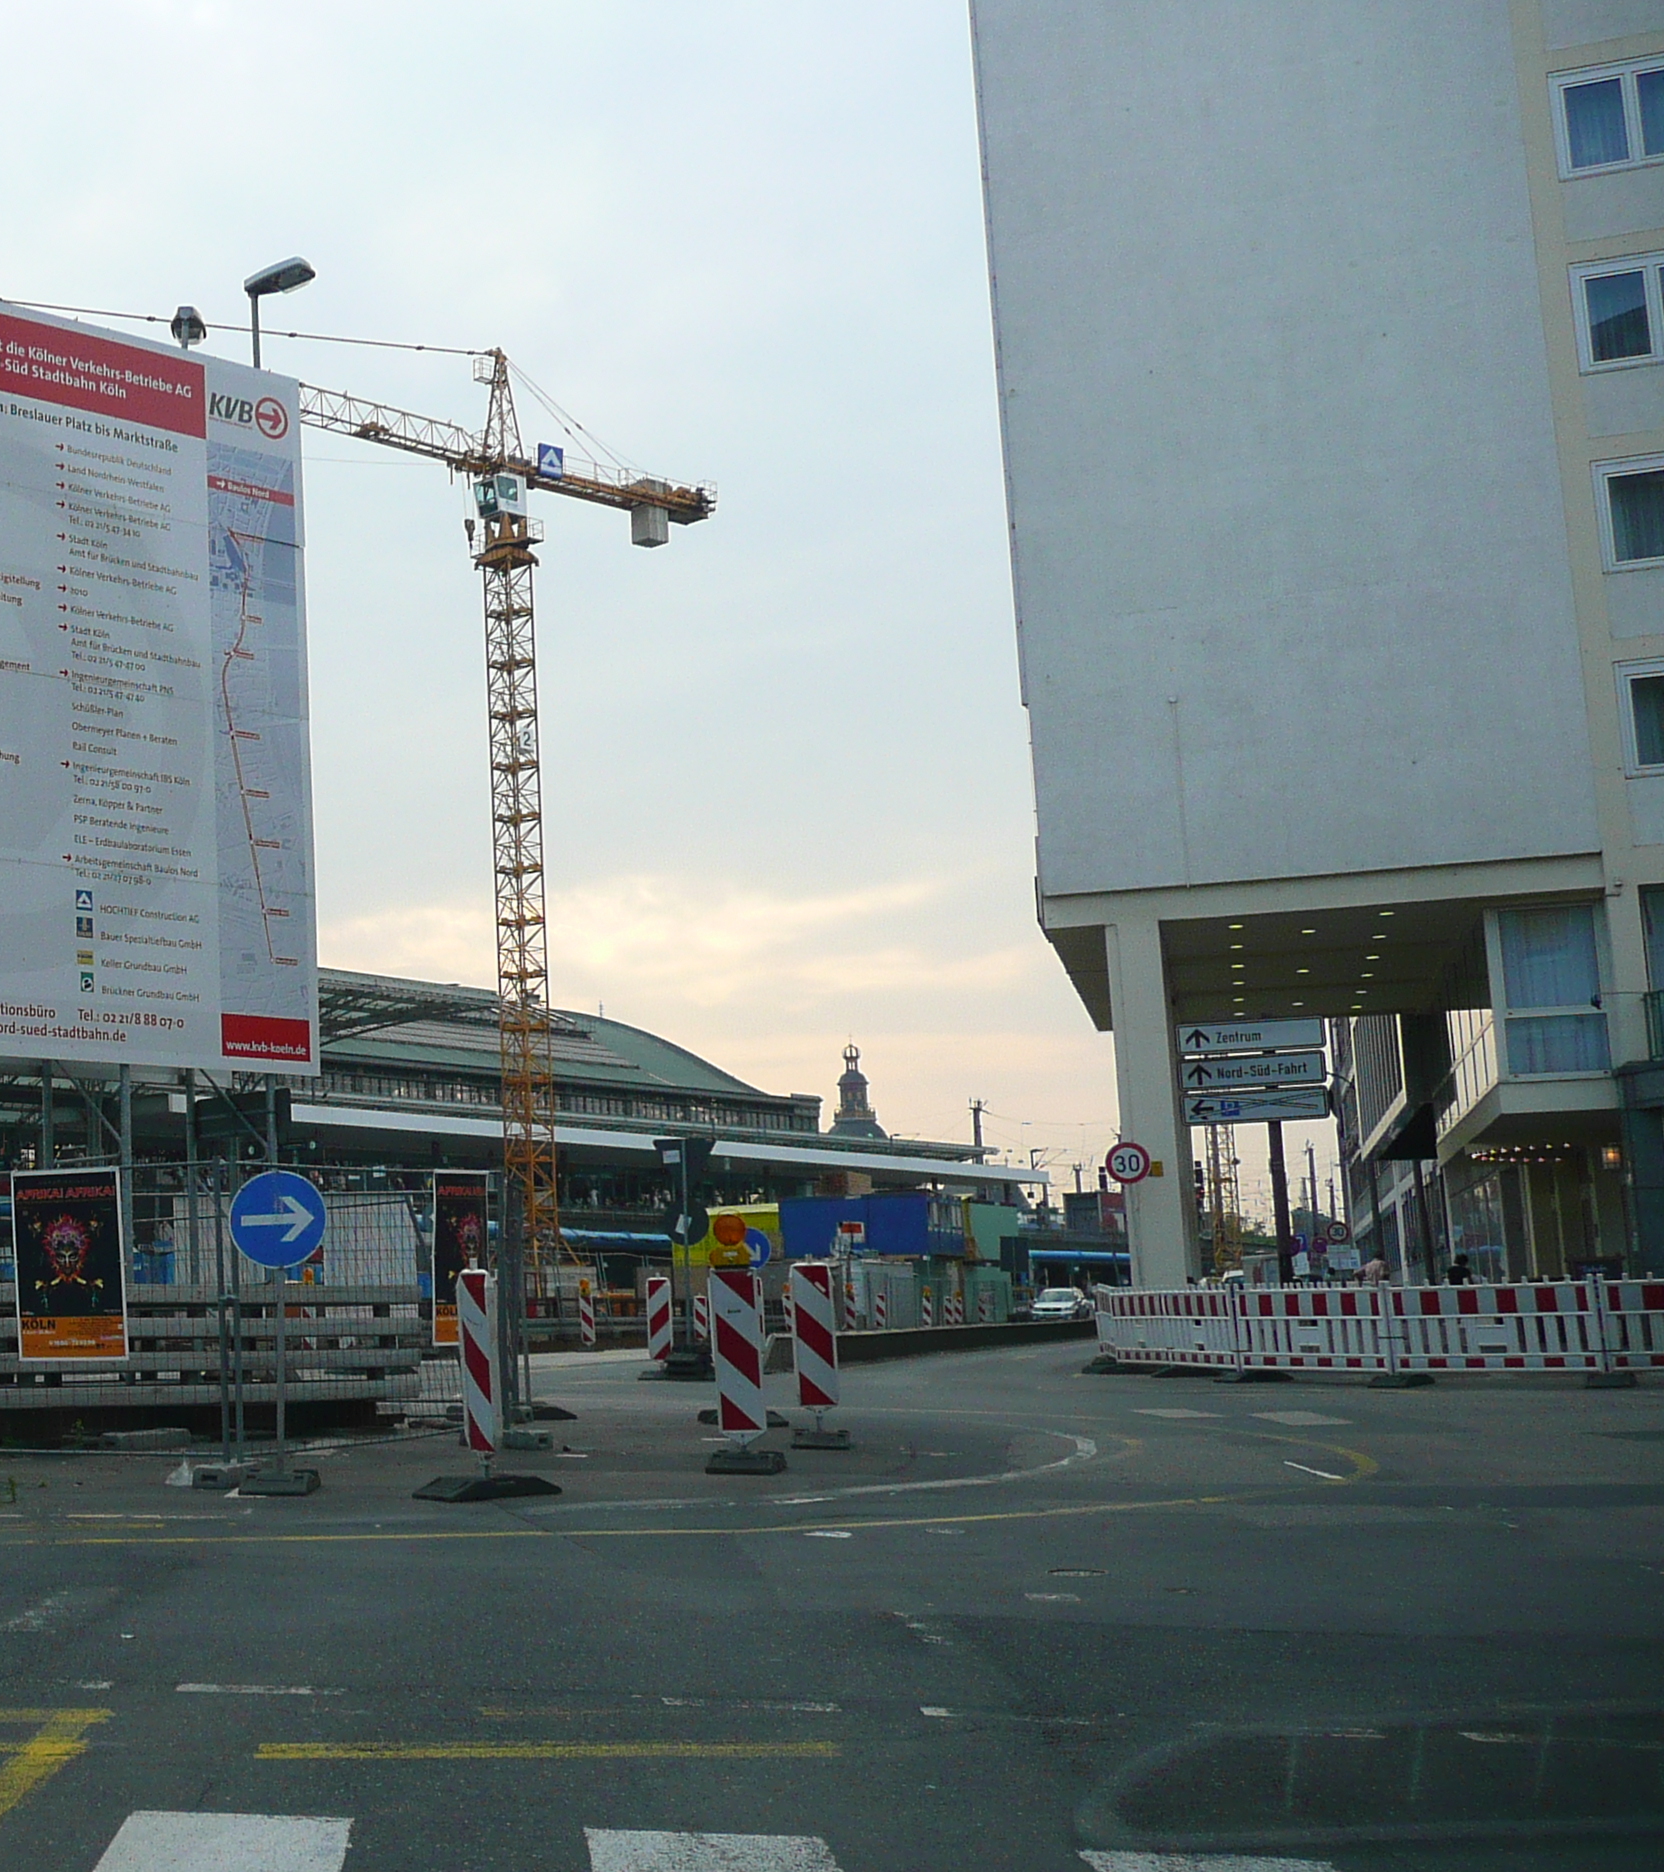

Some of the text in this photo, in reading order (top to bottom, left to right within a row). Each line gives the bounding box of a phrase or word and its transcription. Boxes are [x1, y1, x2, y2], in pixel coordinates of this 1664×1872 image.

[6, 341, 25, 357] die
[28, 346, 67, 366] Kölner
[70, 356, 173, 393] Verkehrs-Betriebe
[175, 383, 192, 398] AG
[31, 365, 96, 392] Stadtbahn
[99, 381, 127, 399] Köln
[209, 392, 254, 424] KVB
[10, 403, 63, 426] Breslauer
[65, 416, 92, 433] Platz
[95, 422, 111, 437] bis
[113, 428, 179, 453] Marktstraße
[67, 445, 172, 476] Bundesrepublik Deutschland
[67, 464, 87, 476] Land
[68, 483, 93, 496] Kölner
[160, 503, 171, 513] AG
[252, 487, 270, 499] Nord
[68, 502, 93, 515] Kölner
[160, 522, 171, 532] AG
[68, 534, 108, 550] Stadt Köln
[68, 547, 86, 558] Amt
[132, 560, 147, 570] und
[69, 566, 95, 580] Kölner
[165, 586, 177, 595] AG
[70, 605, 94, 617] Kölner
[162, 623, 174, 632] AG
[71, 625, 110, 639] Stadt Köln
[71, 637, 87, 648] Amt
[134, 650, 148, 659] und
[71, 670, 158, 692] Ingenieurgemeinschaft
[71, 721, 114, 737] Obermeyer
[116, 728, 141, 740] Planen
[149, 733, 178, 746] Beraten
[72, 741, 118, 756] Rail Consult
[72, 761, 159, 781] Ingenieurgemeinschaft
[174, 776, 191, 786] Köln
[127, 801, 134, 811] &
[135, 803, 163, 815] Partner
[89, 816, 128, 830] Beratende
[129, 822, 170, 835] Ingenieure
[95, 836, 170, 855] Erdbaulaboratorium
[171, 847, 192, 857] Essen
[74, 854, 199, 878] Arbeitsgemeinschaft Baulos Nord
[100, 904, 200, 924] HOCHTIEF Construction AG
[100, 931, 122, 942] Bauer
[124, 933, 177, 948] Spezialtiefbau
[178, 939, 202, 949] GmbH
[101, 958, 187, 974] Keller Grundbau GmbH
[137, 988, 174, 1000] Grundbau
[175, 992, 200, 1002] GmbH
[77, 1008, 100, 1023] Tel.:
[102, 1012, 116, 1023] 02
[118, 1012, 141, 1026] 21/8
[143, 1013, 157, 1026] 88
[1216, 1031, 1262, 1044] Zentrum
[225, 1040, 307, 1055] www.kvb-koeln.de
[1217, 1062, 1308, 1079] Nord-Süd-Fahrt
[1114, 1154, 1140, 1173] 30
[16, 1185, 115, 1200] AFRIKA! AFRIKA!
[1332, 1227, 1345, 1237] 30
[21, 1318, 56, 1330] KÖLN
